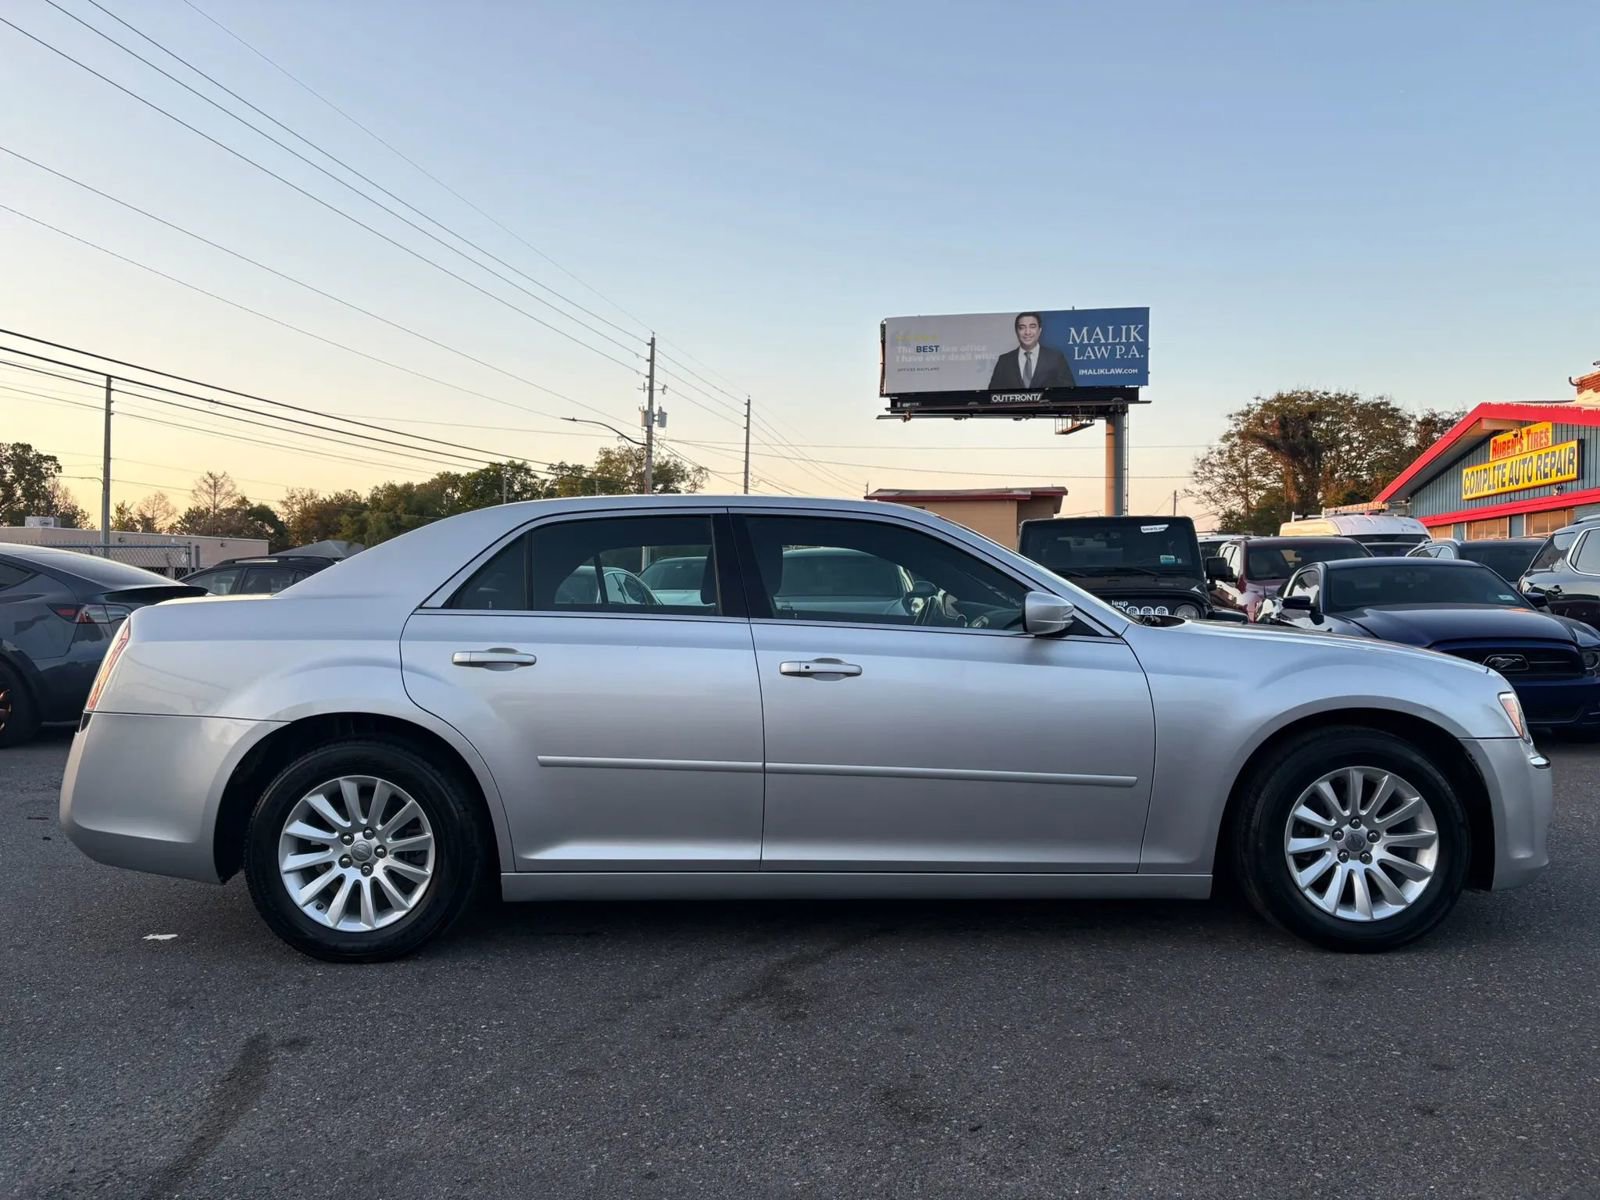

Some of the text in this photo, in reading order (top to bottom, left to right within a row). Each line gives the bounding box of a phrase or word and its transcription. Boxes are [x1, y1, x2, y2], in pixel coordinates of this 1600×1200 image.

[1068, 324, 1144, 344] MALIK
[915, 345, 940, 353] BEST
[1074, 345, 1144, 360] LAW P.A.
[1464, 447, 1576, 495] COMPLETE AUTO REPAIR
